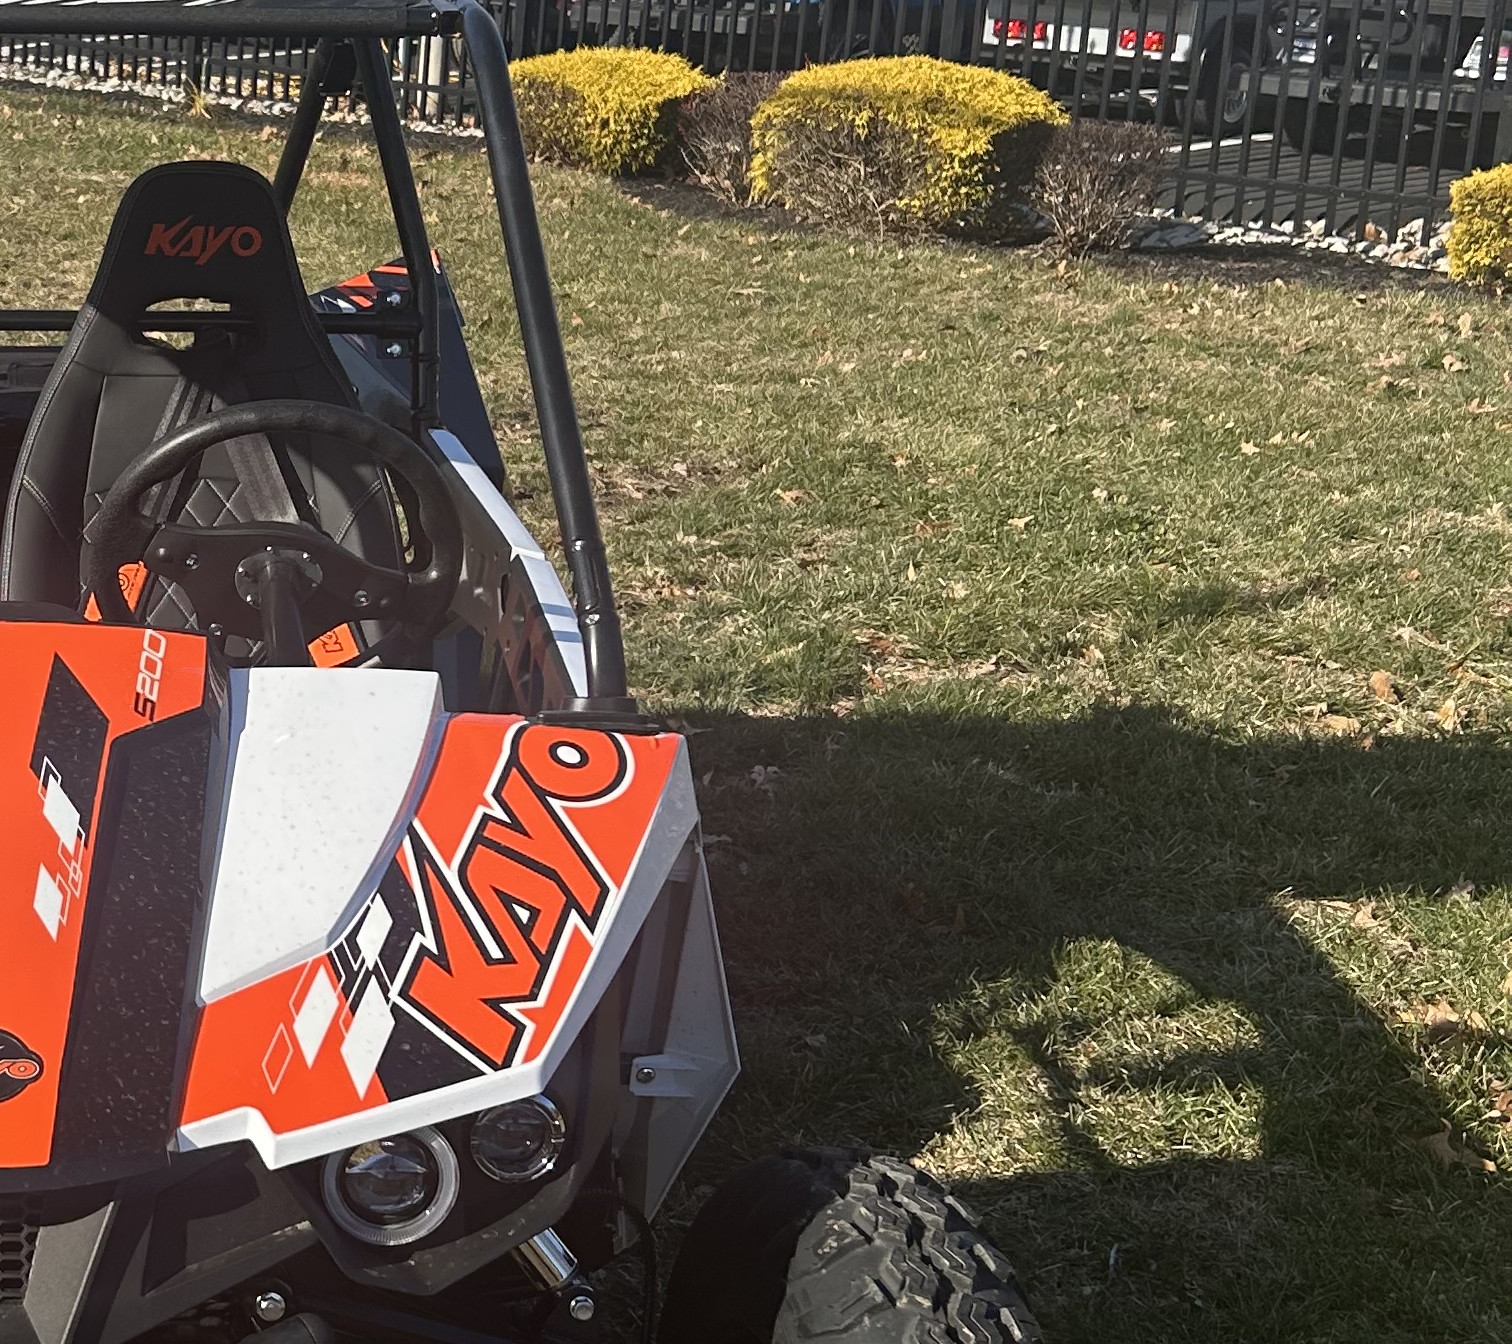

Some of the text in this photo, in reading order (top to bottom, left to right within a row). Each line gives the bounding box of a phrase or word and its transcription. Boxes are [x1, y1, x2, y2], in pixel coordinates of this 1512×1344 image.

[144, 215, 262, 265] KAYO
[133, 628, 168, 723] S200
[400, 722, 626, 1071] KAYO
